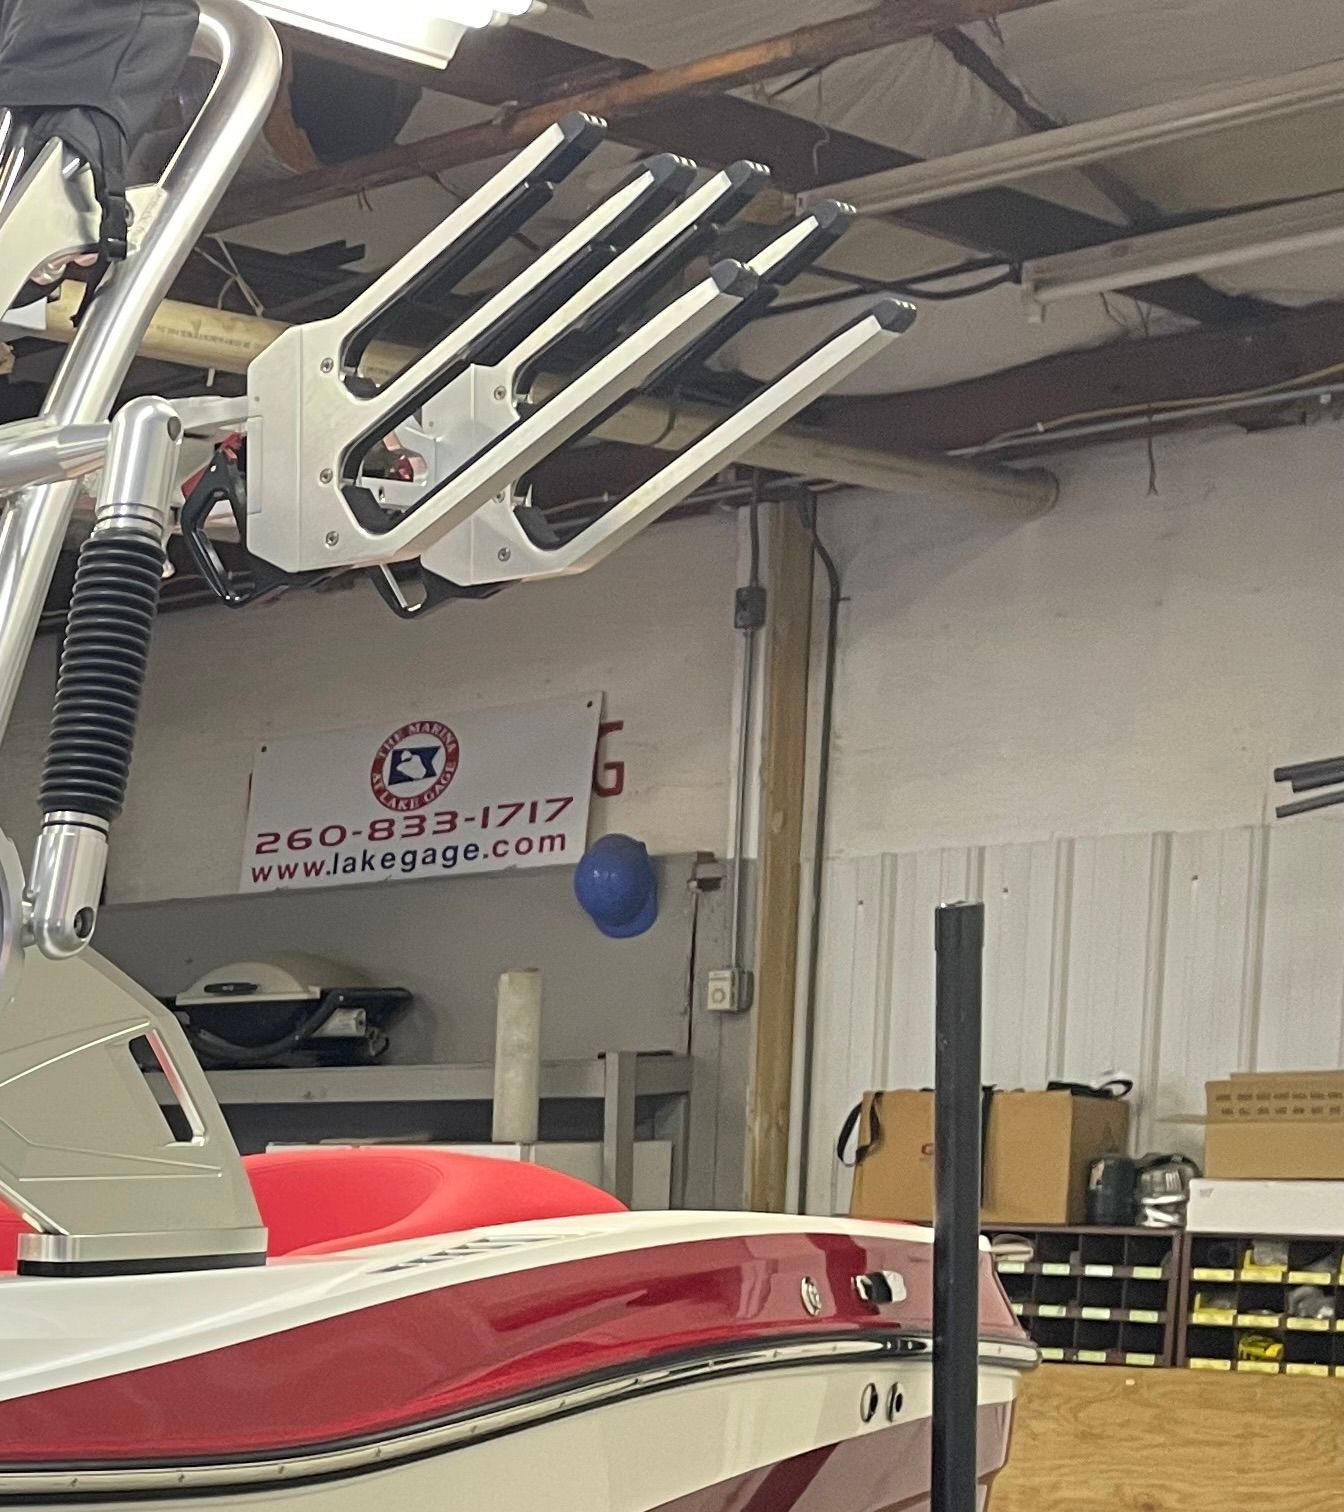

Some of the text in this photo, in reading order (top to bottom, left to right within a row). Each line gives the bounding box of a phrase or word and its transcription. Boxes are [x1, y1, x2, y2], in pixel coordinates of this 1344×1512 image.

[378, 722, 457, 758] THE MARINA
[379, 790, 420, 810] LAKE
[423, 761, 457, 802] GAGE
[255, 796, 575, 855] 260-833-1717
[251, 832, 567, 883] www.lakegage.com
